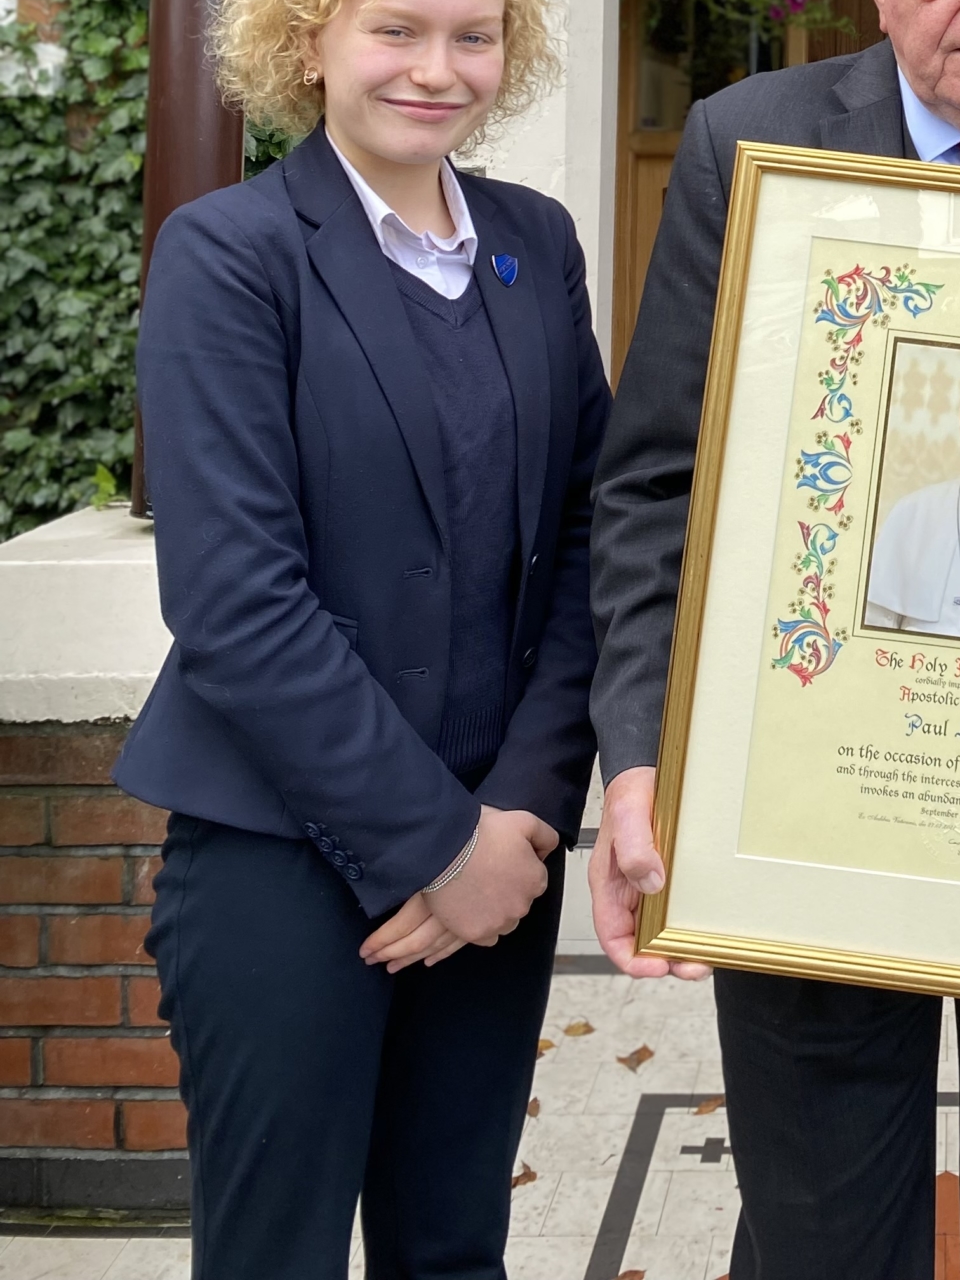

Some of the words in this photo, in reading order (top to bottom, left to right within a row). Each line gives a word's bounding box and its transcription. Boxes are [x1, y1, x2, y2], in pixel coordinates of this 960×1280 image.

[875, 648, 904, 670] The
[909, 652, 948, 677] Holy
[915, 676, 947, 688] cordially
[899, 685, 960, 707] Apostolic
[904, 712, 950, 736] Paul
[837, 745, 854, 757] on
[859, 744, 880, 762] the
[884, 751, 942, 768] occasion
[836, 764, 856, 775] and
[858, 765, 899, 782] through
[901, 770, 918, 784] the
[860, 783, 899, 798] invokes
[902, 790, 915, 800] an
[920, 806, 959, 819] September
